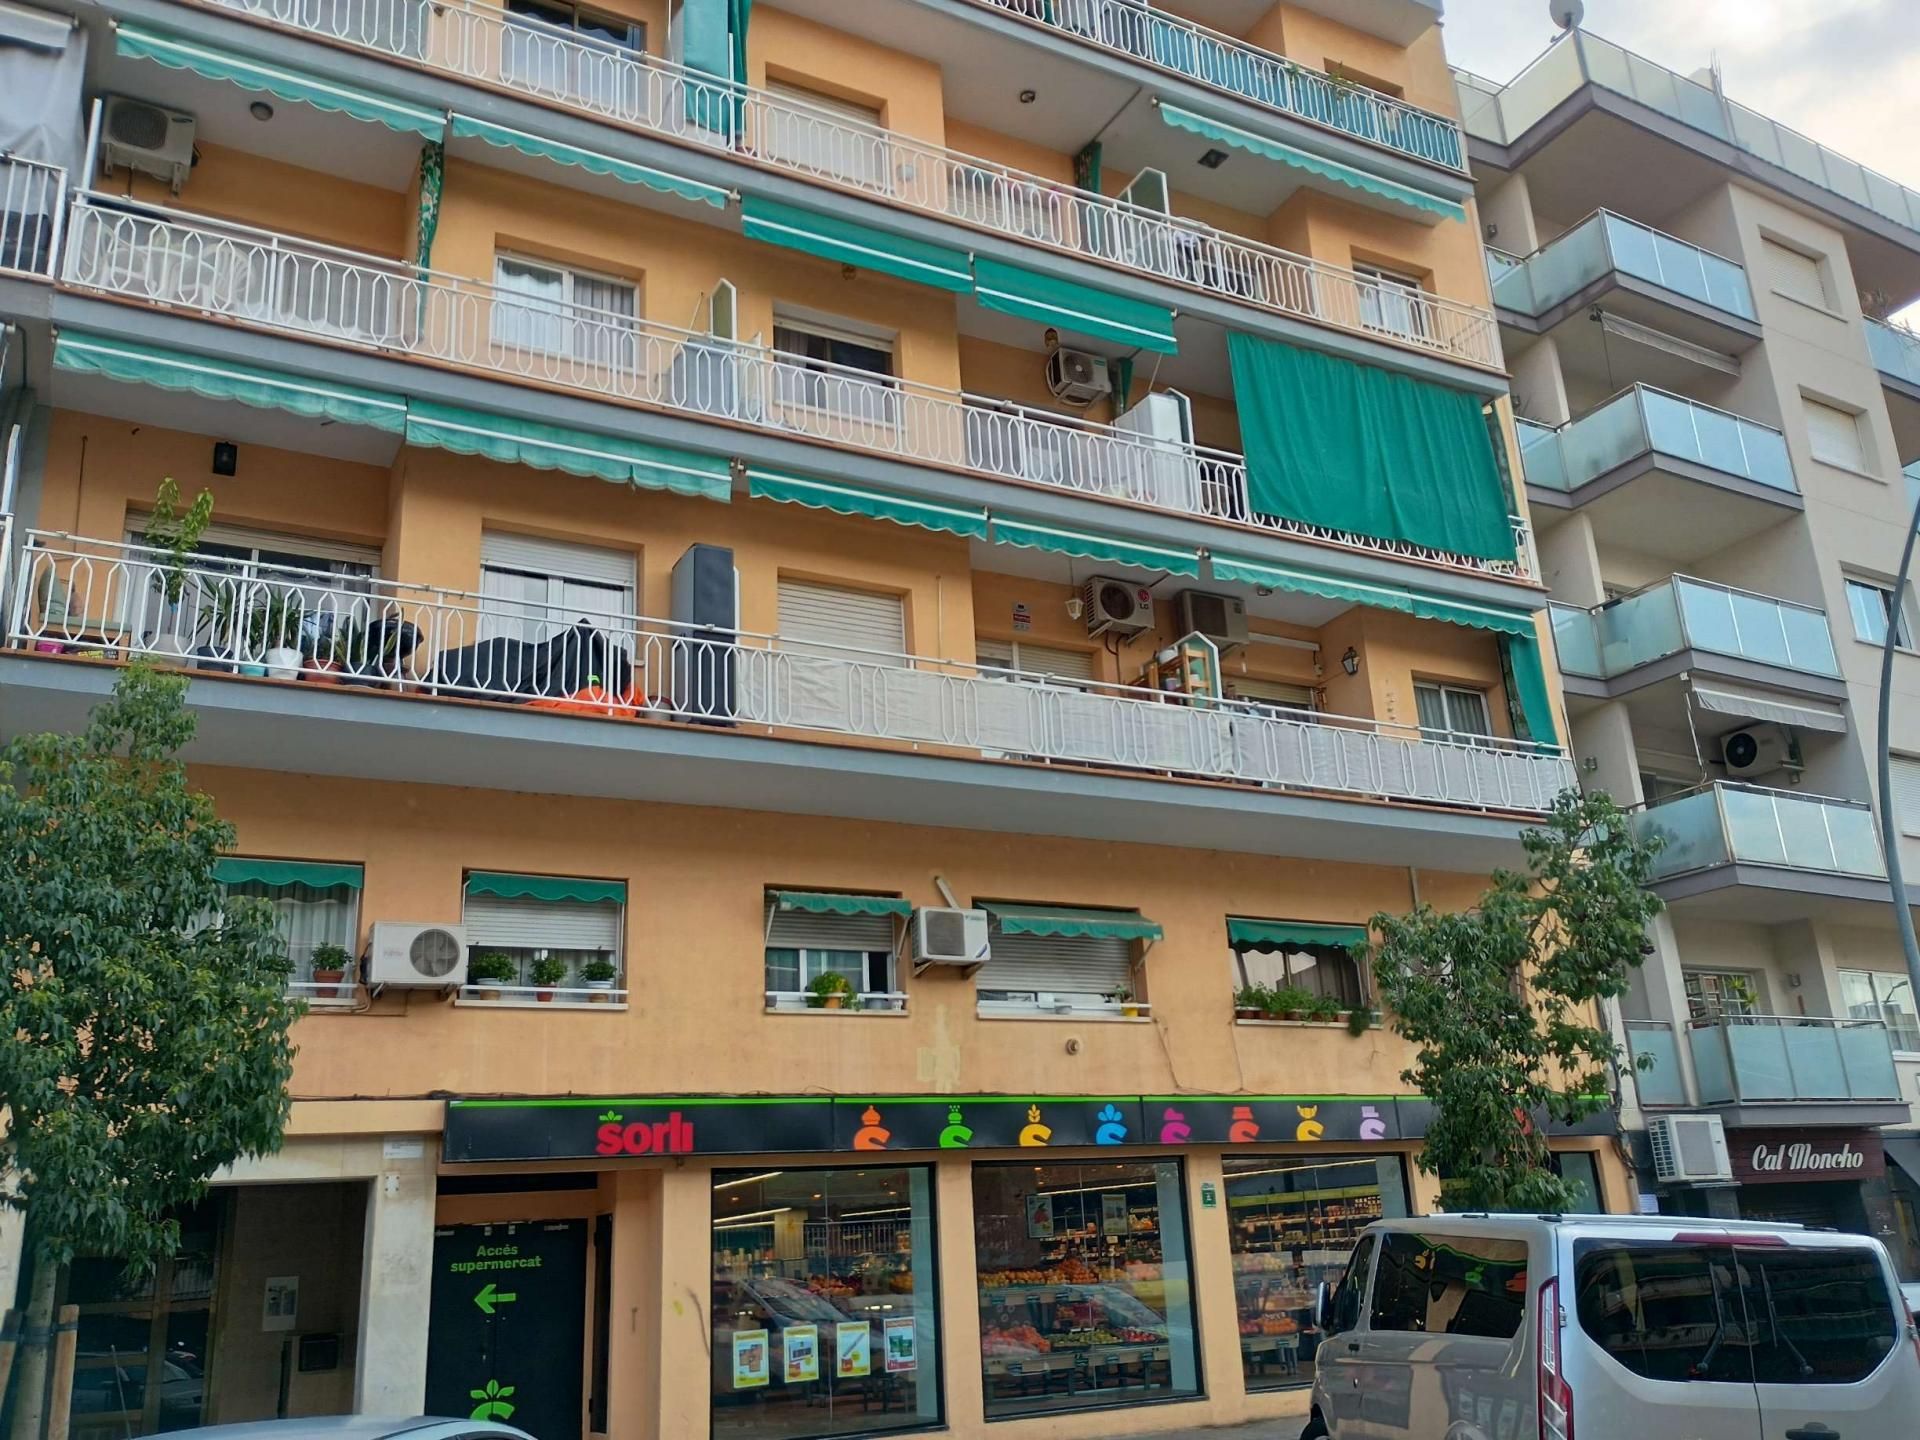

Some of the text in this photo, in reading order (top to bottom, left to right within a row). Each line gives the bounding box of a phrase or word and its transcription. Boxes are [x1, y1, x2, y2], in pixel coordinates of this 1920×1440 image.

[595, 1111, 694, 1156] sorli
[1752, 1143, 1864, 1171] Cal Moncho
[450, 1256, 542, 1274] supermercat
